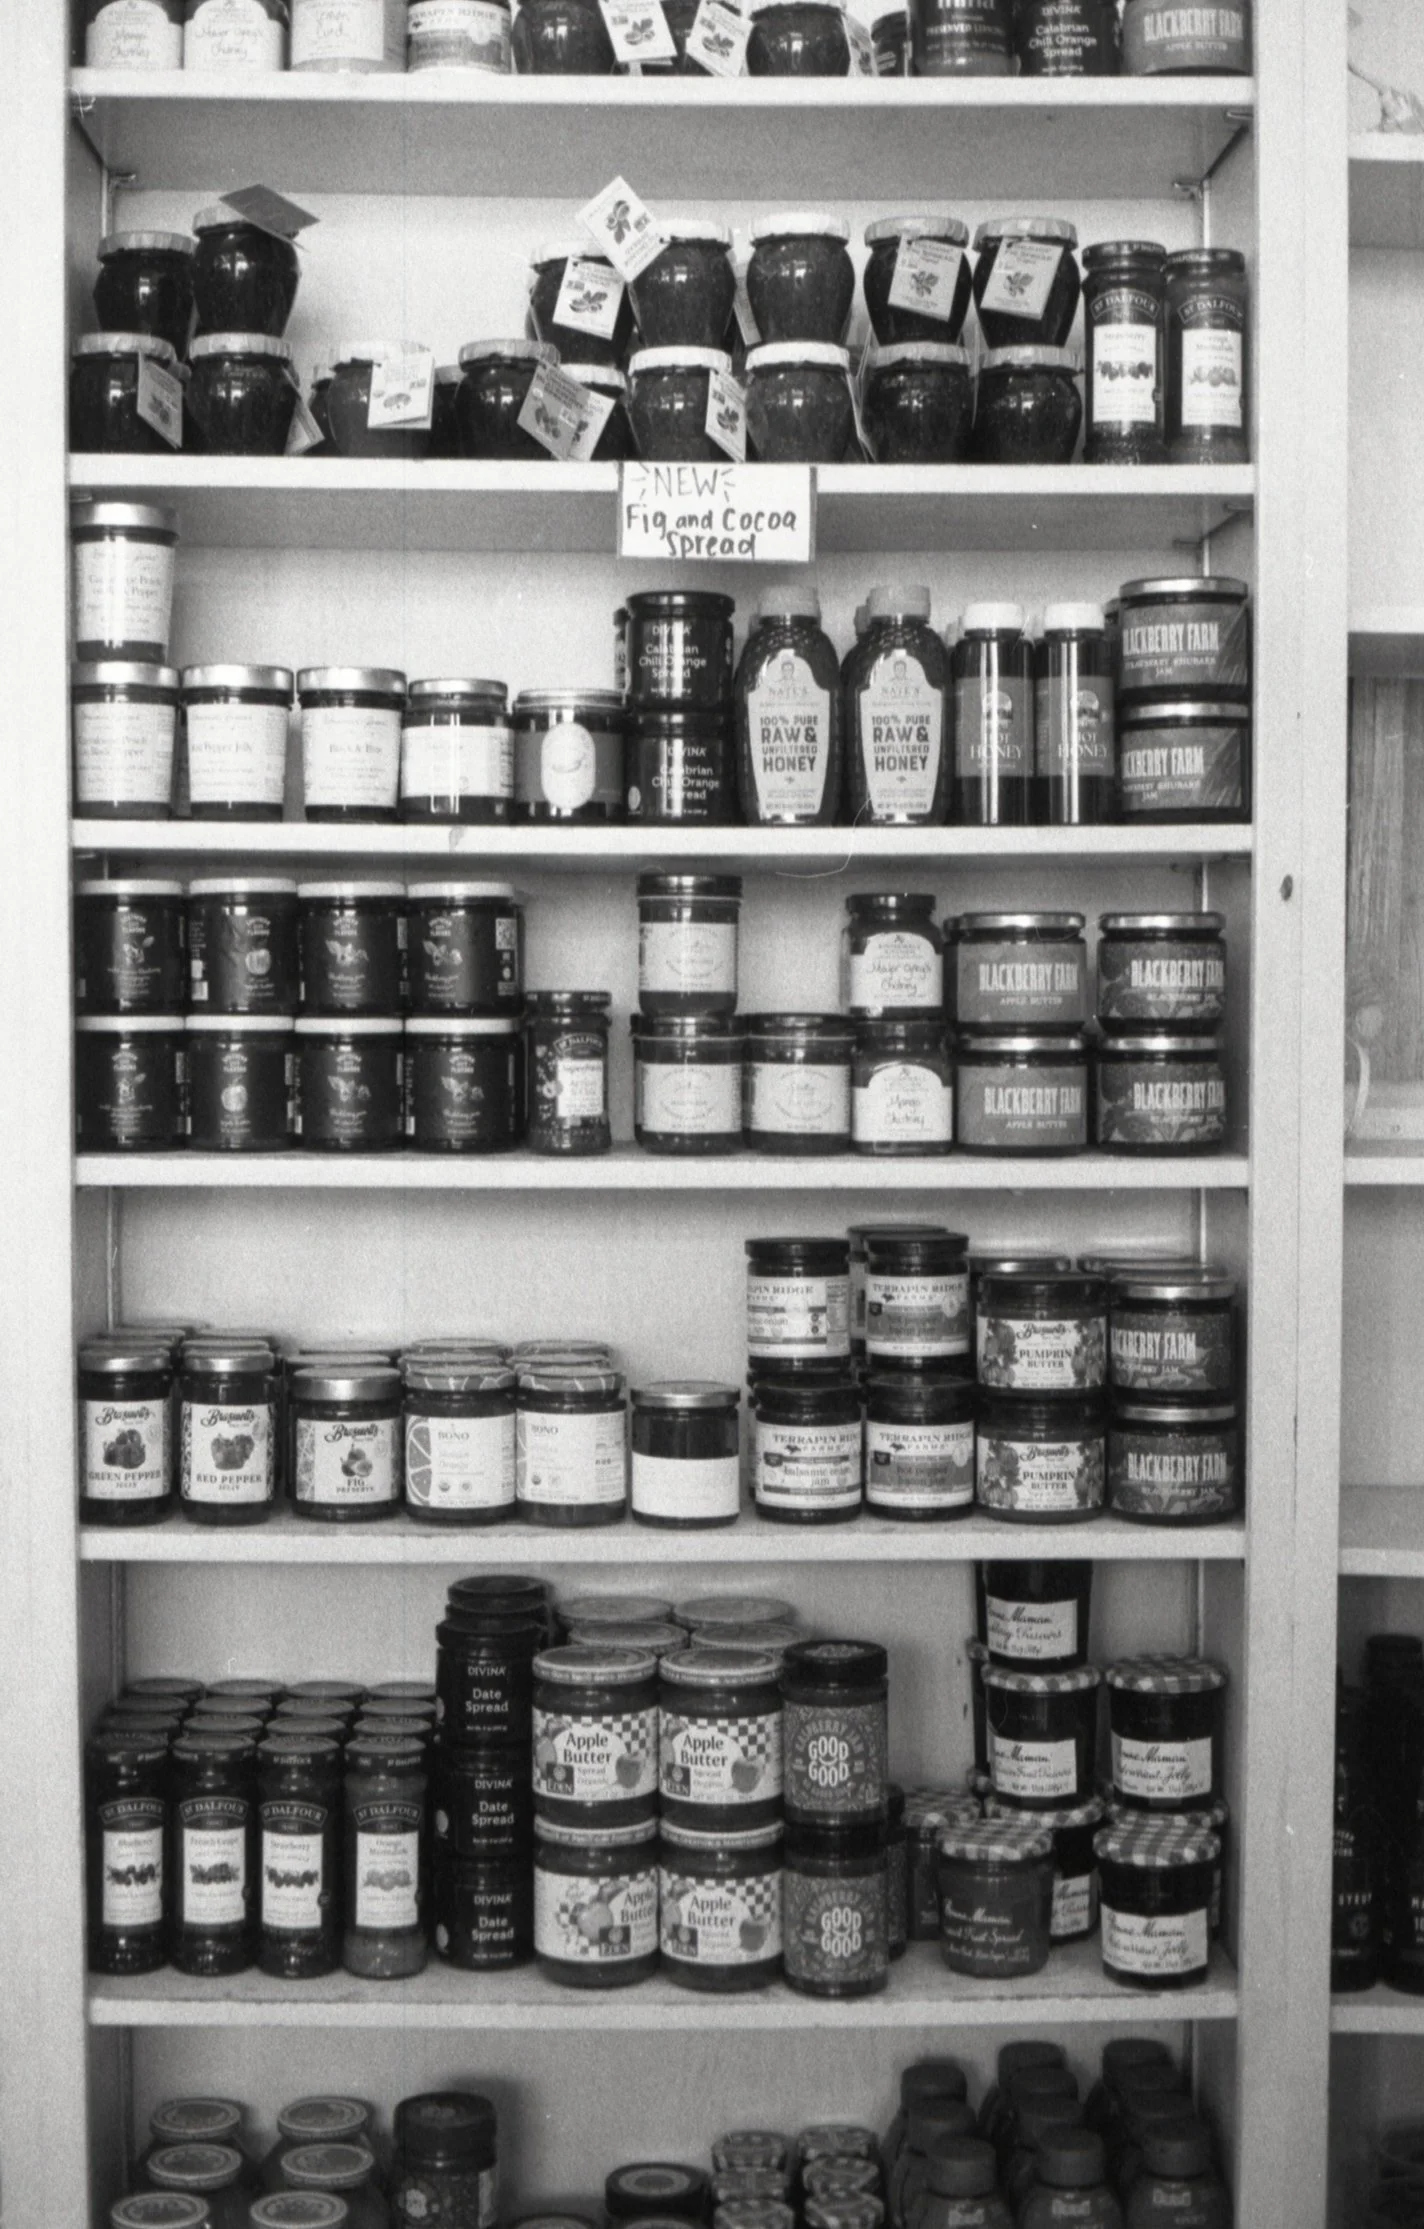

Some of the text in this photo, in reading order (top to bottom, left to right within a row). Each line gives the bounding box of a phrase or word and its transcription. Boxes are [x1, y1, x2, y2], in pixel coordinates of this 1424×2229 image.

[1036, 23, 1090, 36] Calabrian
[1144, 8, 1217, 41] BLACKBERRY
[1055, 34, 1097, 47] Orange
[1043, 47, 1083, 58] Spread
[654, 466, 718, 497] NEW
[626, 504, 797, 540] Fig and Cocoa
[666, 531, 756, 558] Spread
[1187, 622, 1219, 651] FARM
[760, 715, 818, 726] 100% PURE
[872, 715, 931, 726] 100% PURE
[761, 727, 817, 743] RAW &
[873, 727, 929, 743] RAW &
[762, 745, 818, 755] UNFILTERED
[874, 745, 929, 755] UNFILTERED
[763, 756, 816, 772] HONEY
[875, 756, 927, 772] HONEY
[1171, 746, 1204, 775] FARM
[979, 963, 1052, 991] BLACKBERRY
[1131, 960, 1204, 988] BLACKBERRY
[984, 1087, 1058, 1115] BLACKBERRY
[1133, 1082, 1206, 1110] BLACKBERRY
[1019, 1349, 1072, 1359] PUMPKIN
[1164, 1332, 1196, 1360] FARM
[1027, 1360, 1064, 1368] BUTTER
[773, 1434, 836, 1445] TERRAPIN
[880, 1433, 940, 1442] TERRAPIN
[125, 1470, 161, 1480] PEPPER
[1127, 1452, 1199, 1482] BLACKBERRY
[196, 1474, 262, 1483] RED PEPPER
[346, 1479, 365, 1487] FIG
[1022, 1471, 1075, 1480] PUMPKIN
[1031, 1482, 1067, 1490] BUTTER
[468, 1666, 506, 1676] DIVINA
[472, 1688, 502, 1700] Date
[465, 1701, 509, 1713] Spread
[566, 1732, 608, 1750] Apple
[683, 1734, 724, 1753] Apple
[808, 1736, 849, 1761] GOOD
[563, 1748, 612, 1764] Butter
[681, 1750, 728, 1767] Butter
[808, 1761, 849, 1787] GOOD
[475, 1779, 513, 1789] DIVINA
[272, 1805, 321, 1821] DALFOUR
[369, 1804, 418, 1818] DALFOUR
[479, 1801, 508, 1812] Date
[472, 1814, 514, 1826] Spread
[474, 1895, 513, 1905] DIVINA
[690, 1895, 732, 1913] Apple
[479, 1916, 508, 1928] Date
[687, 1911, 735, 1927] Butter
[821, 1907, 862, 1932] GOOD
[472, 1929, 514, 1942] Spread
[821, 1933, 862, 1958] GOOD
